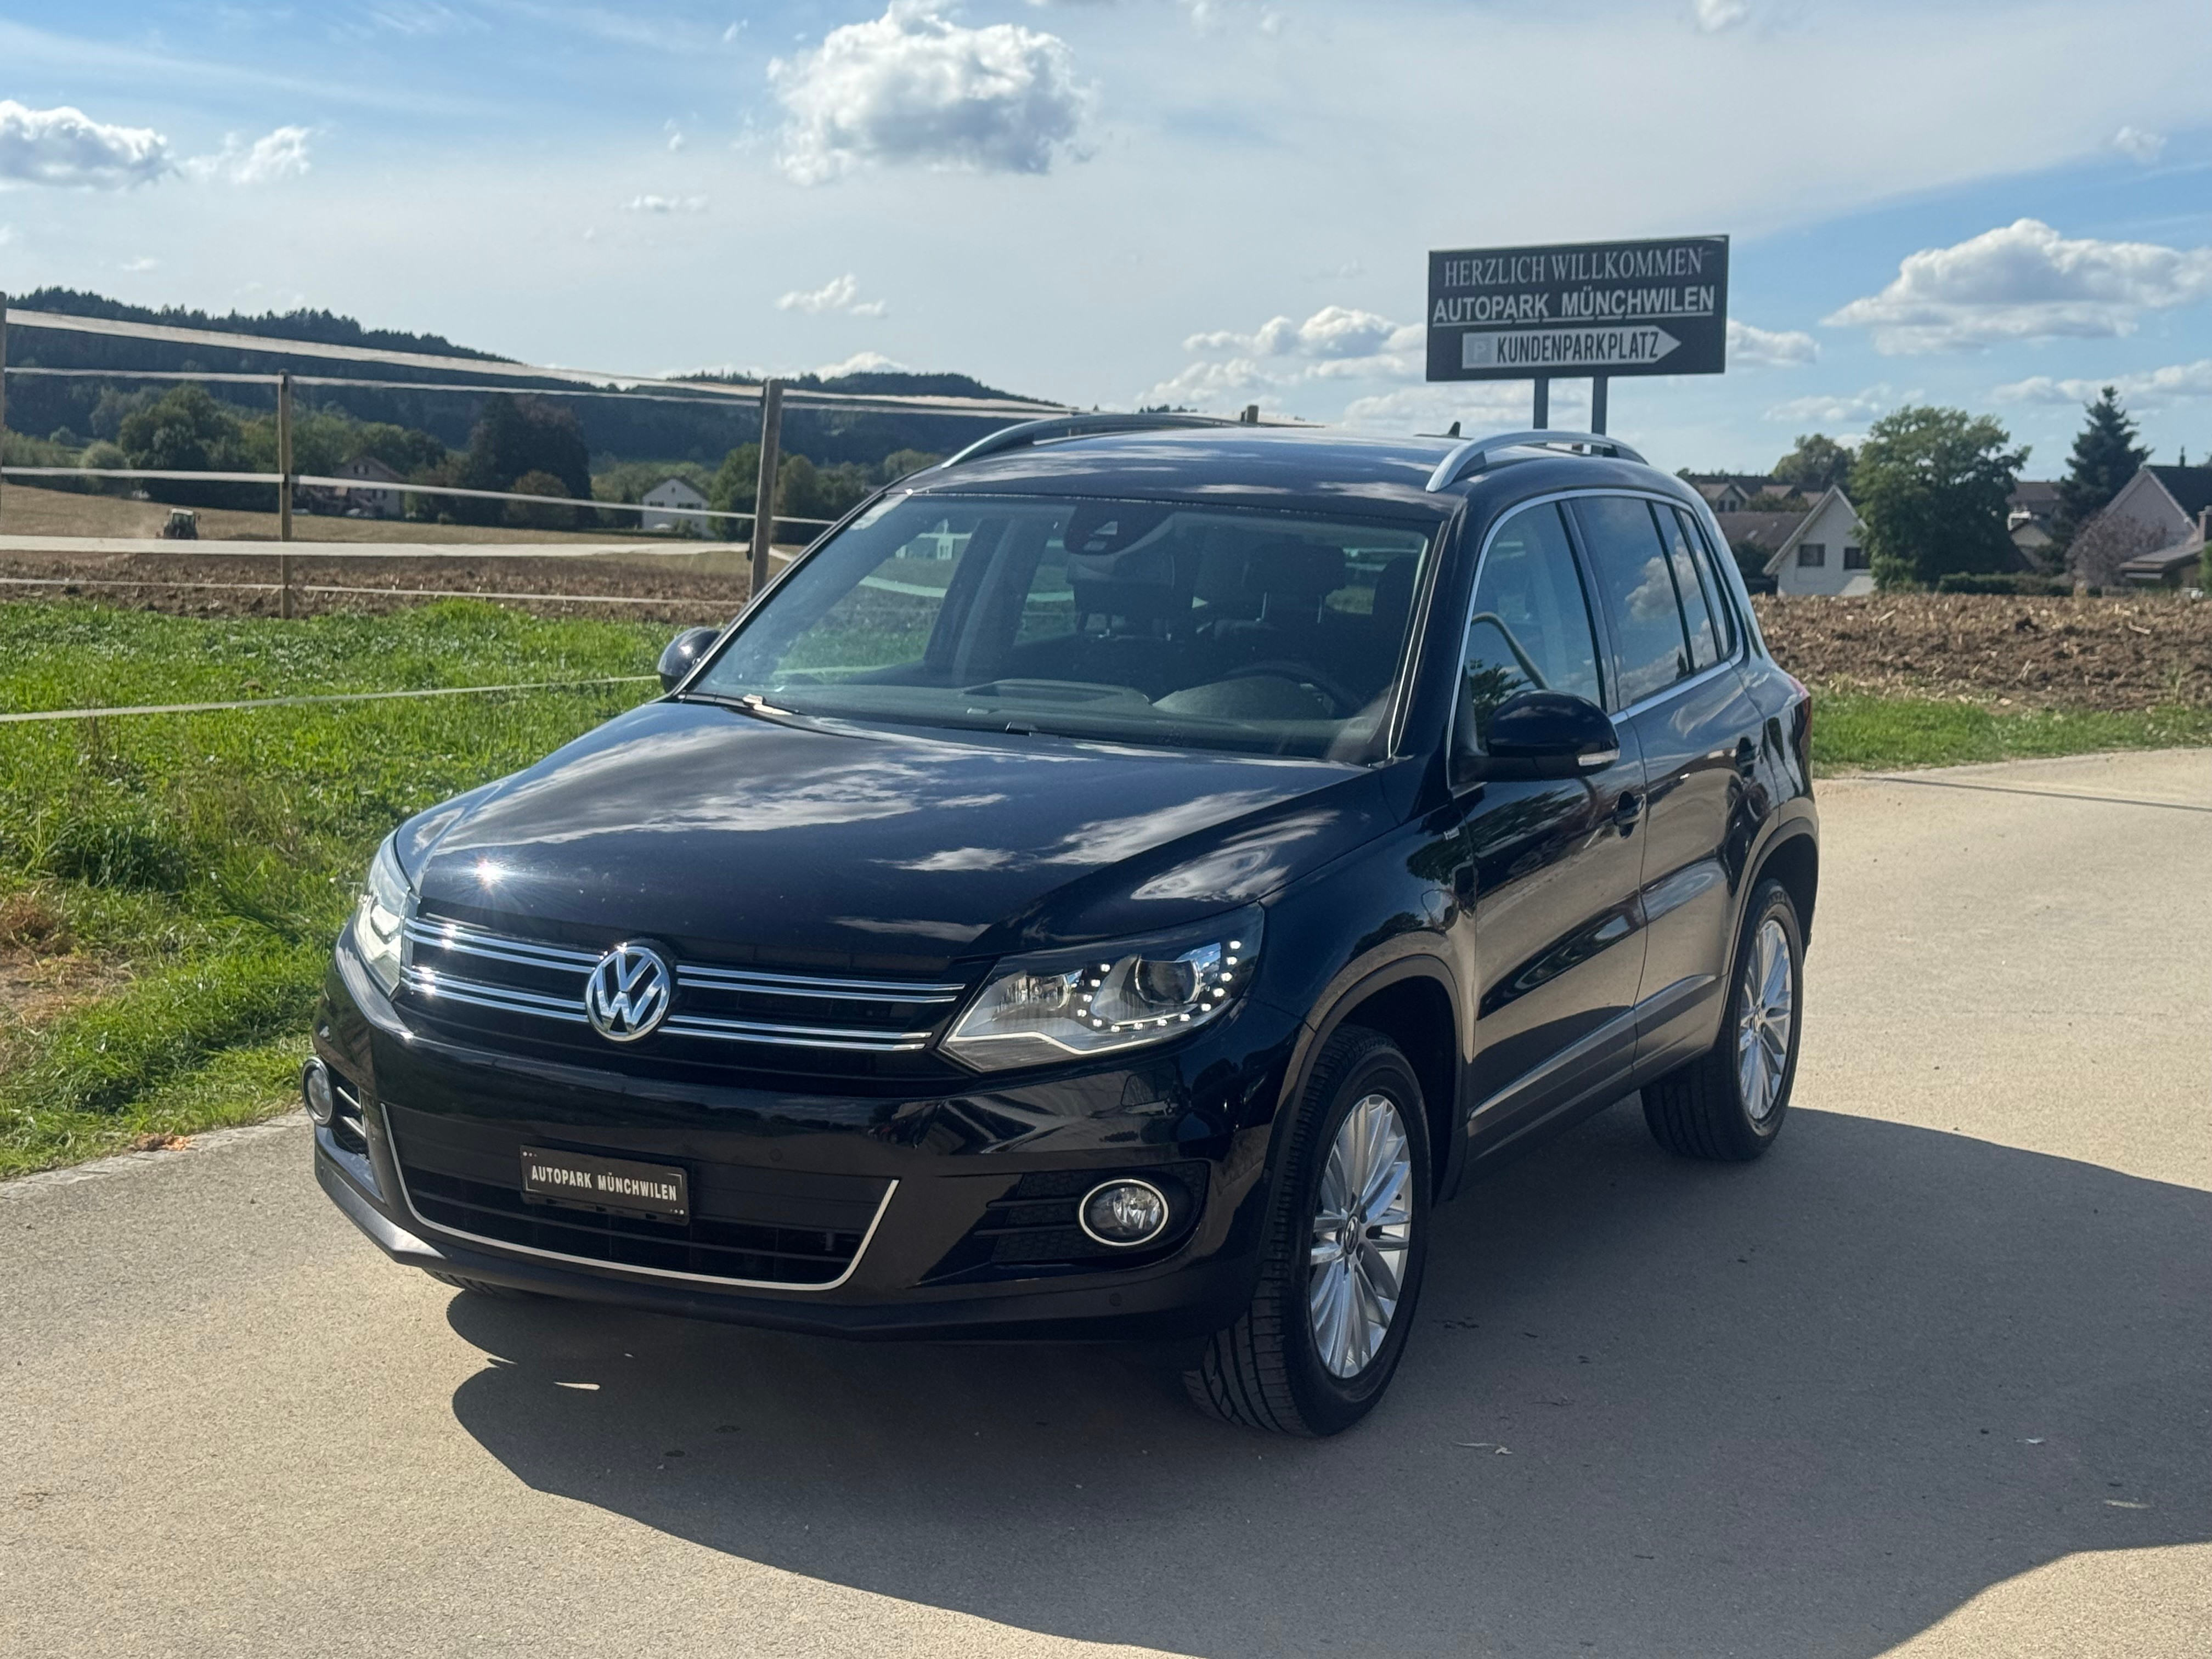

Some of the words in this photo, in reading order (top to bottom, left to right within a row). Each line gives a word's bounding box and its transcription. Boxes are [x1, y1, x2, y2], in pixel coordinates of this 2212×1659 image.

[1444, 256, 1545, 287] HERZLICH
[1551, 247, 1702, 280] WILLKOMMEN
[1433, 293, 1549, 323] AUTOPARK
[1561, 285, 1715, 317] MÜNCHWILEN
[1497, 331, 1659, 363] KUNDENPARKPLATZ
[589, 948, 669, 1039] VW
[532, 1165, 592, 1188] AUTOPARK
[597, 1172, 677, 1201] MÜNCHWILEN
